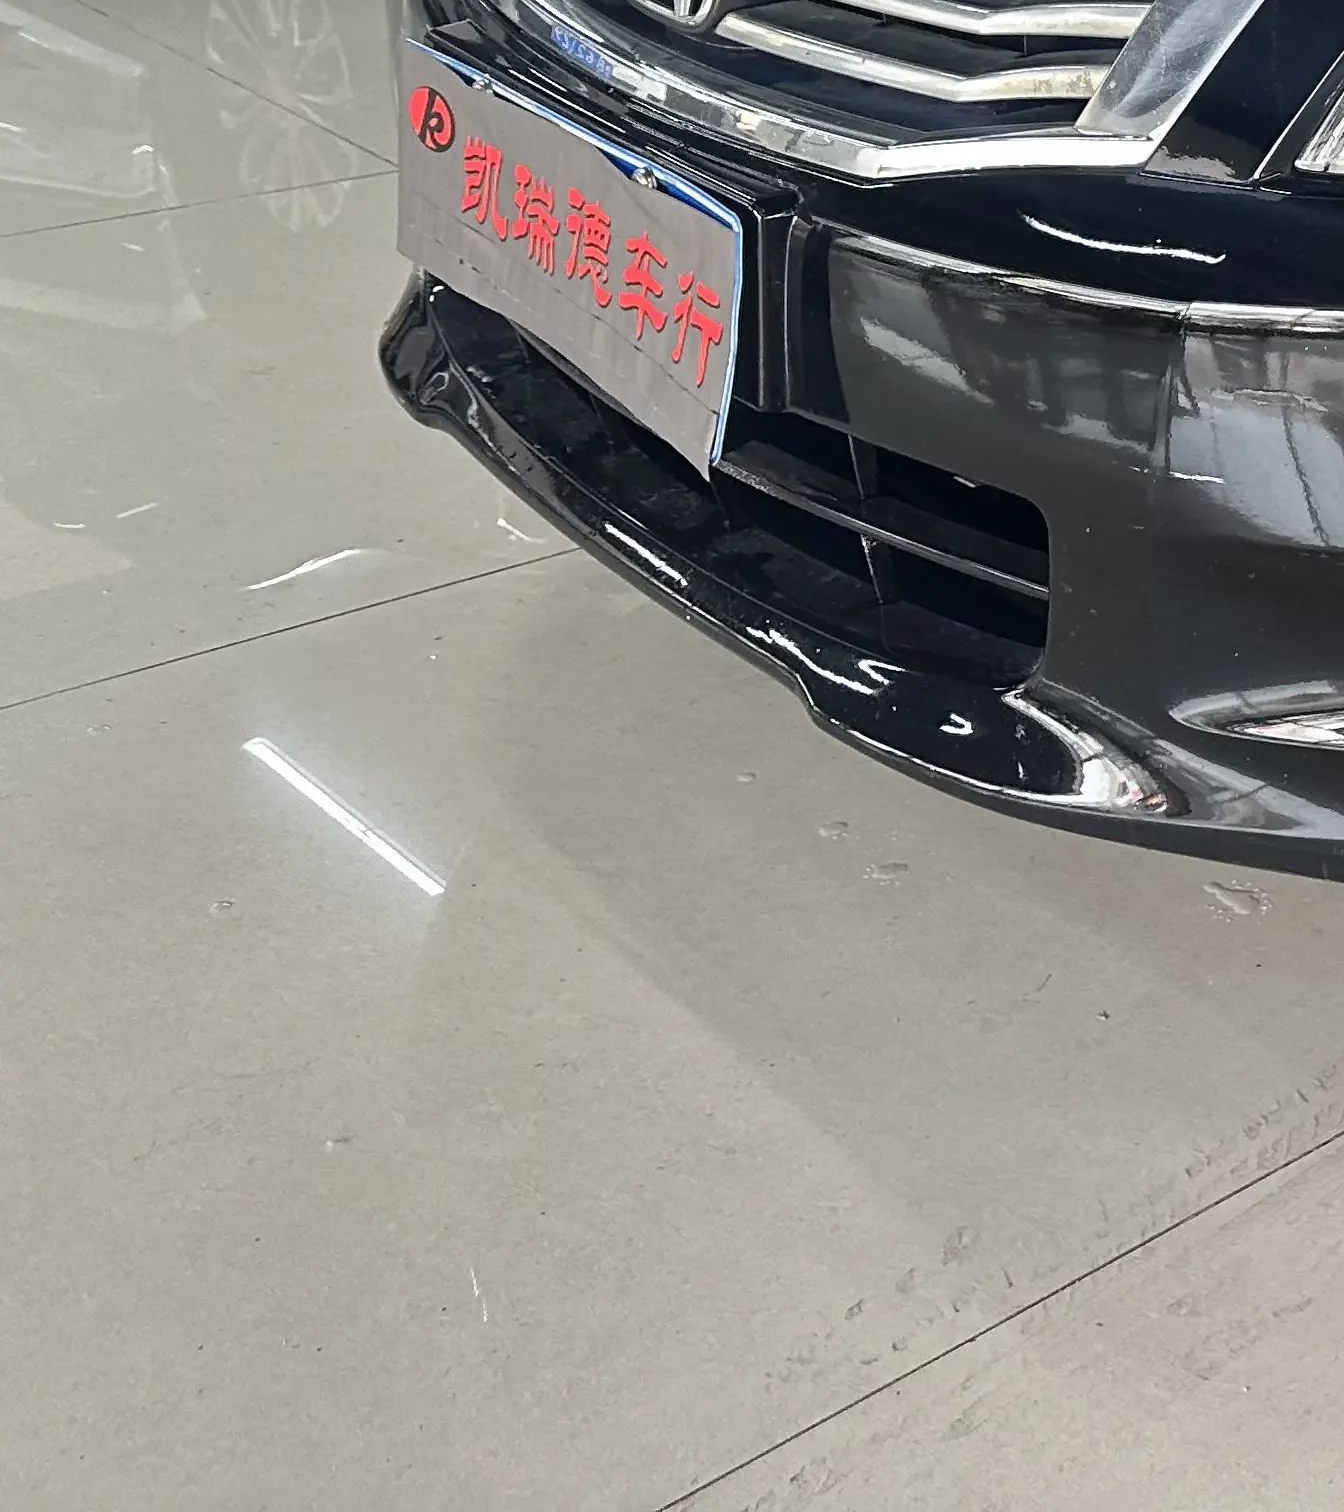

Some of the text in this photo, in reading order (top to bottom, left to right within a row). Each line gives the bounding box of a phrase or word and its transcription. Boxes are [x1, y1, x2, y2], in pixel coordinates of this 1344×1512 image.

[460, 135, 724, 388] 凯瑞德车行
